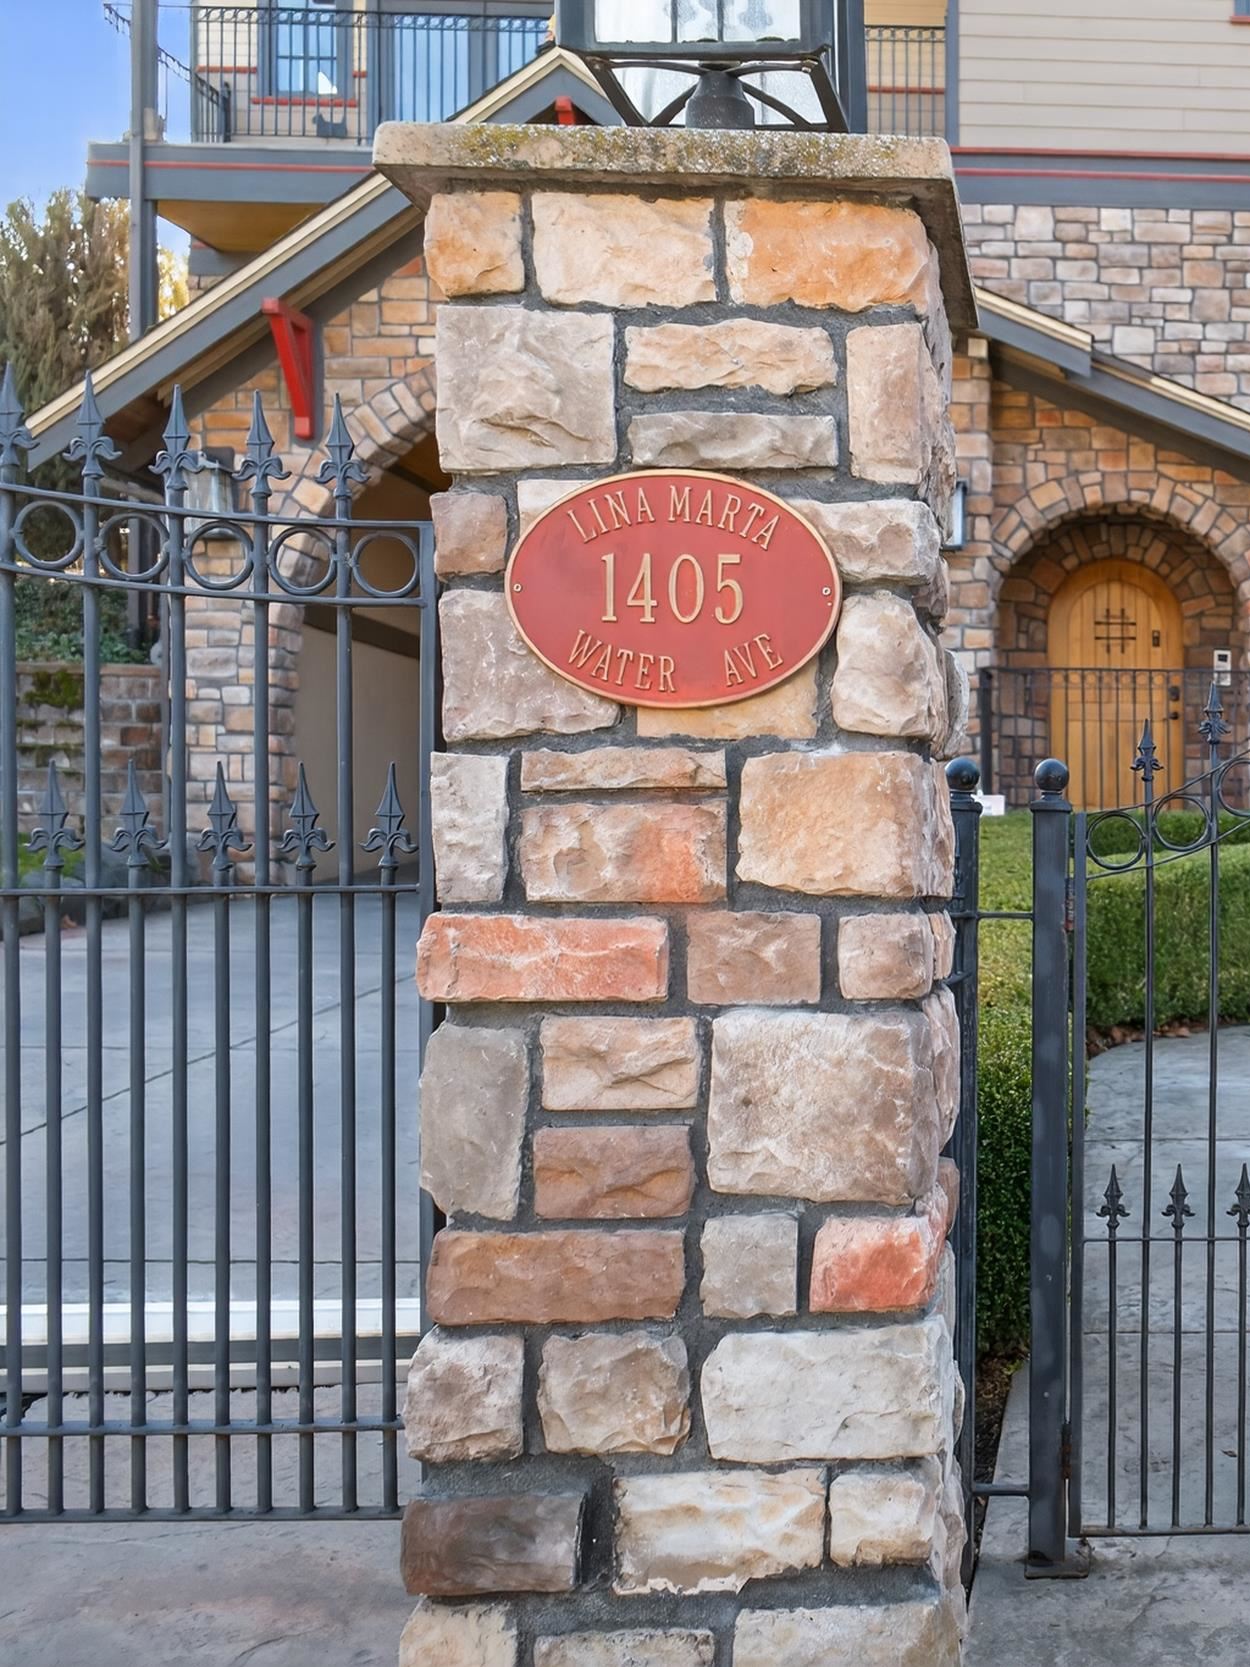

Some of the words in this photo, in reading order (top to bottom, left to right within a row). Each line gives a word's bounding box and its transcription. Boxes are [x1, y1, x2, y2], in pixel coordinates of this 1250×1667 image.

[567, 486, 655, 544] LINA
[668, 484, 781, 551] MARTA
[600, 552, 744, 625] 1405
[567, 628, 677, 693] WATER
[723, 632, 784, 688] AVE
